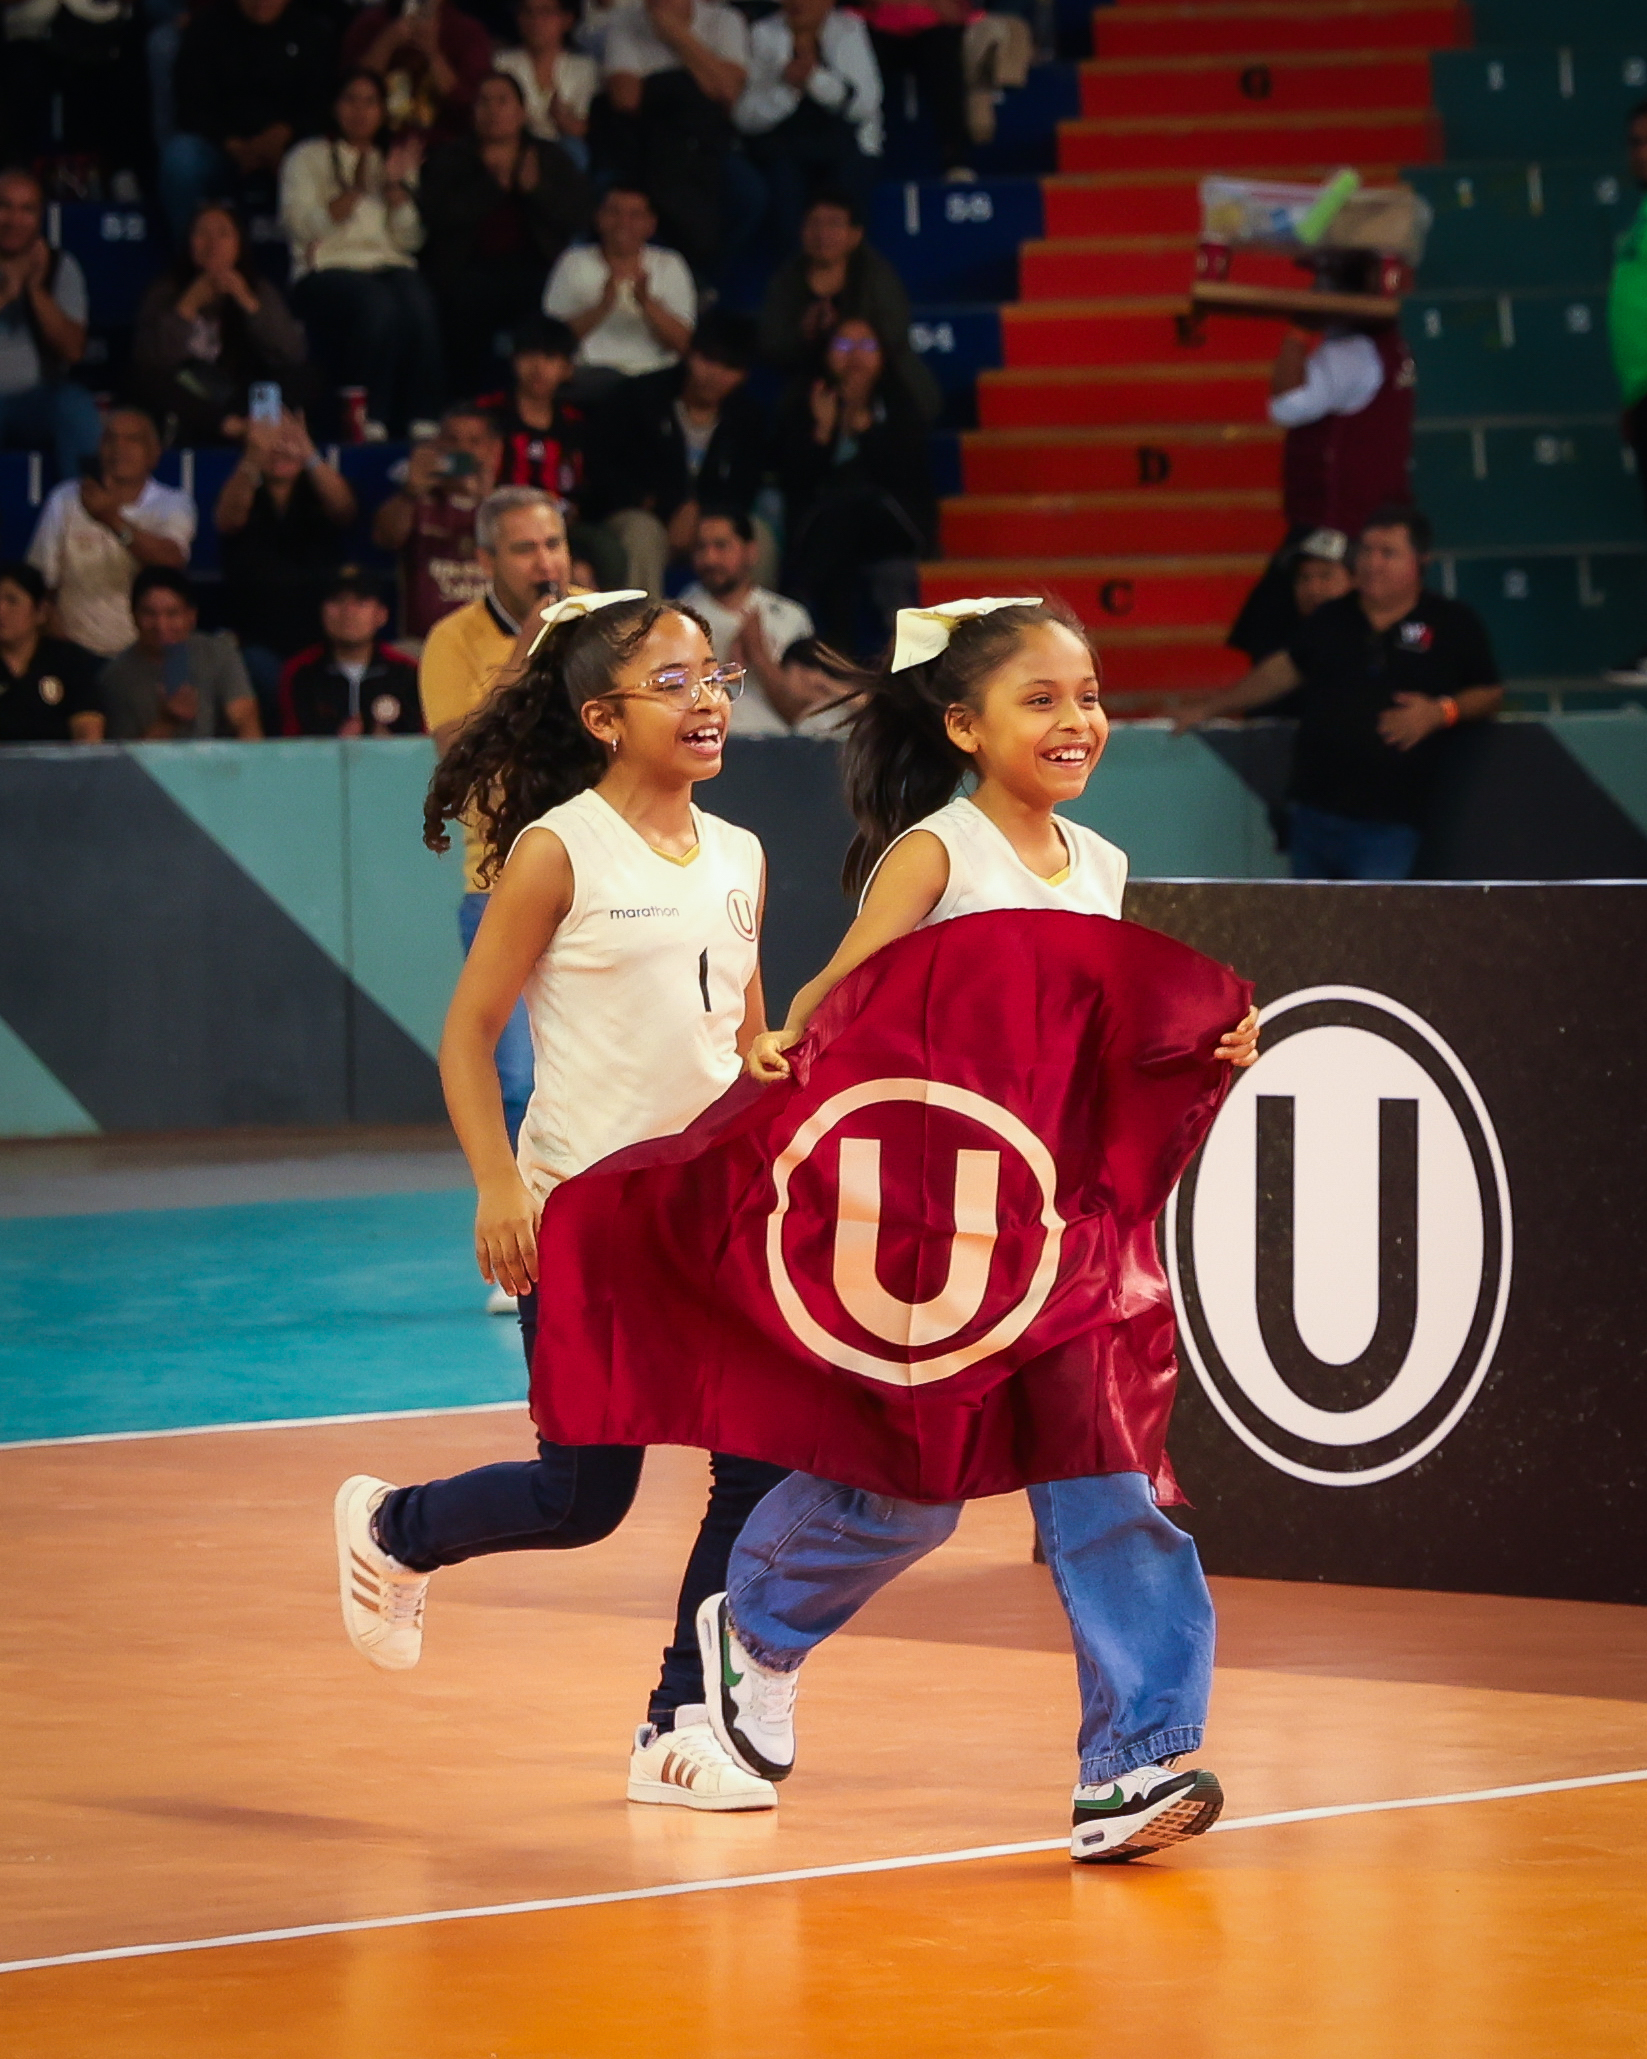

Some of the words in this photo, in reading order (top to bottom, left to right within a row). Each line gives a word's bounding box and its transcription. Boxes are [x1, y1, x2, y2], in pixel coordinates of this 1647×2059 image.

[1137, 447, 1171, 484] D
[1099, 579, 1133, 616] C
[609, 905, 680, 920] marathon
[832, 1136, 1000, 1347] U
[1256, 1095, 1420, 1414] U
